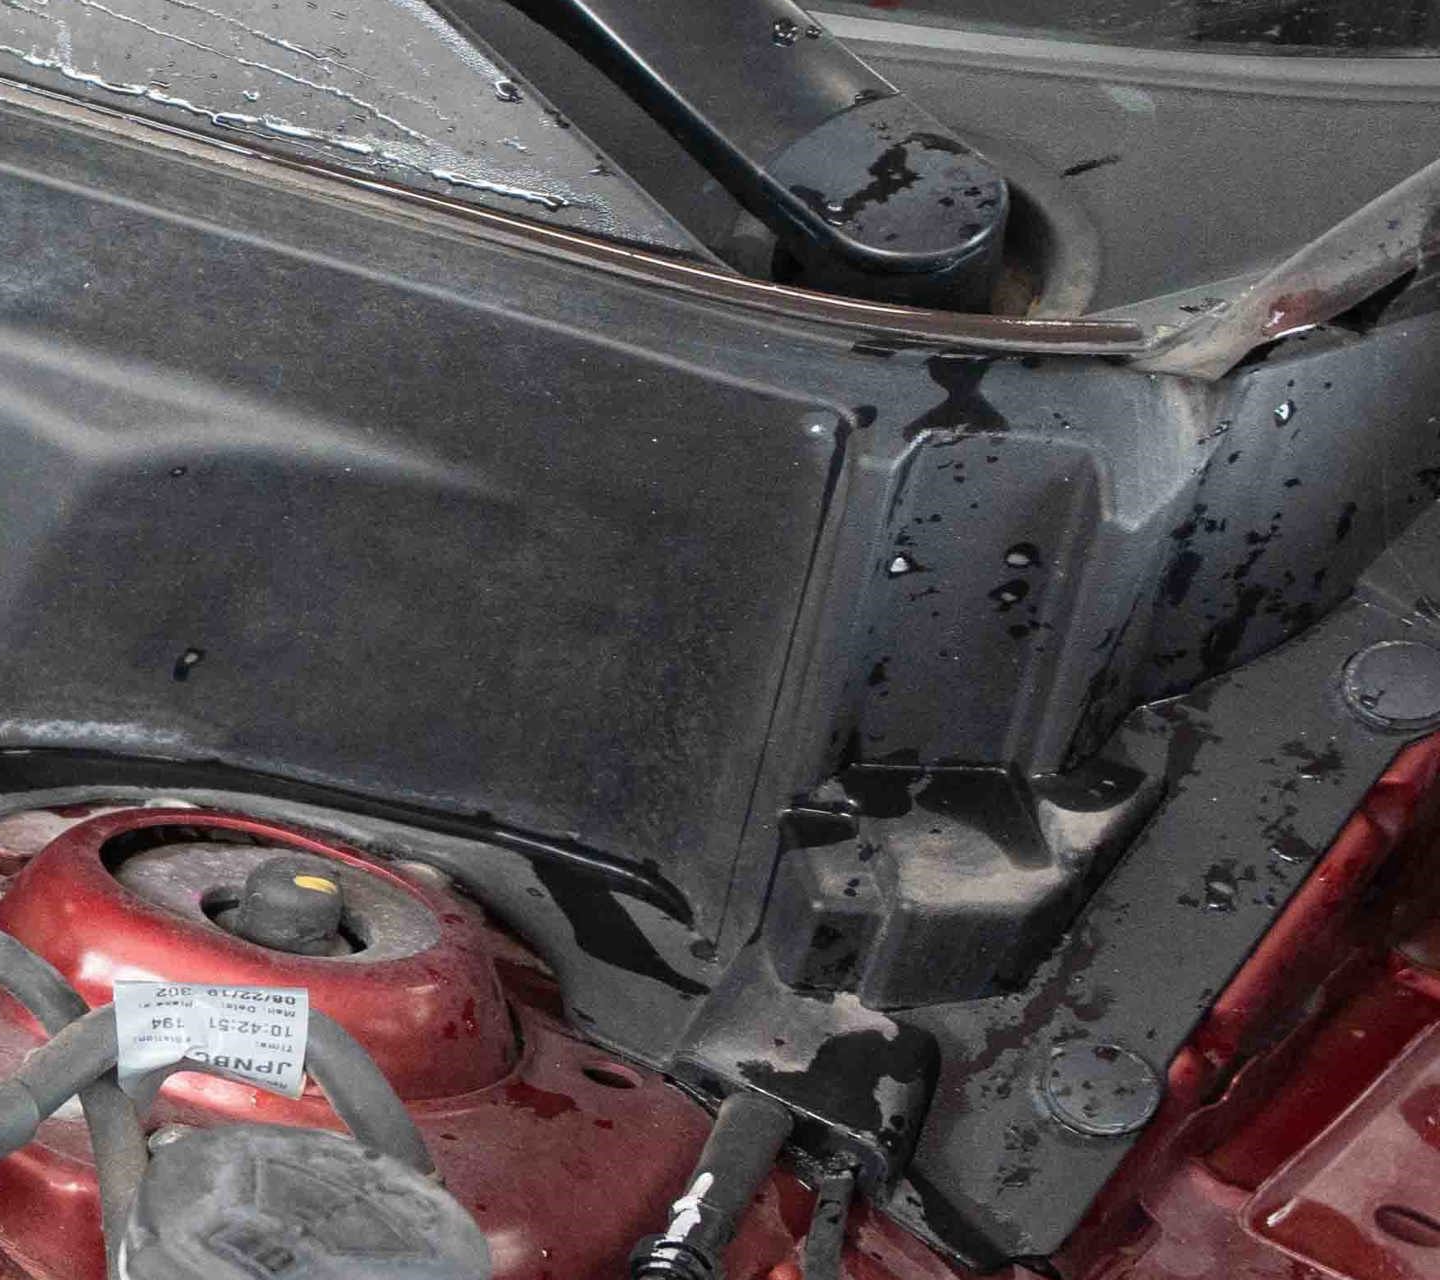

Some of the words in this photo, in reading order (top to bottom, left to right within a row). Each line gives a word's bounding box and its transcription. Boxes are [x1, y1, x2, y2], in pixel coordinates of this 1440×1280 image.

[156, 987, 192, 997] 302
[152, 1018, 184, 1030] 194
[209, 1017, 293, 1037] 10:42:51
